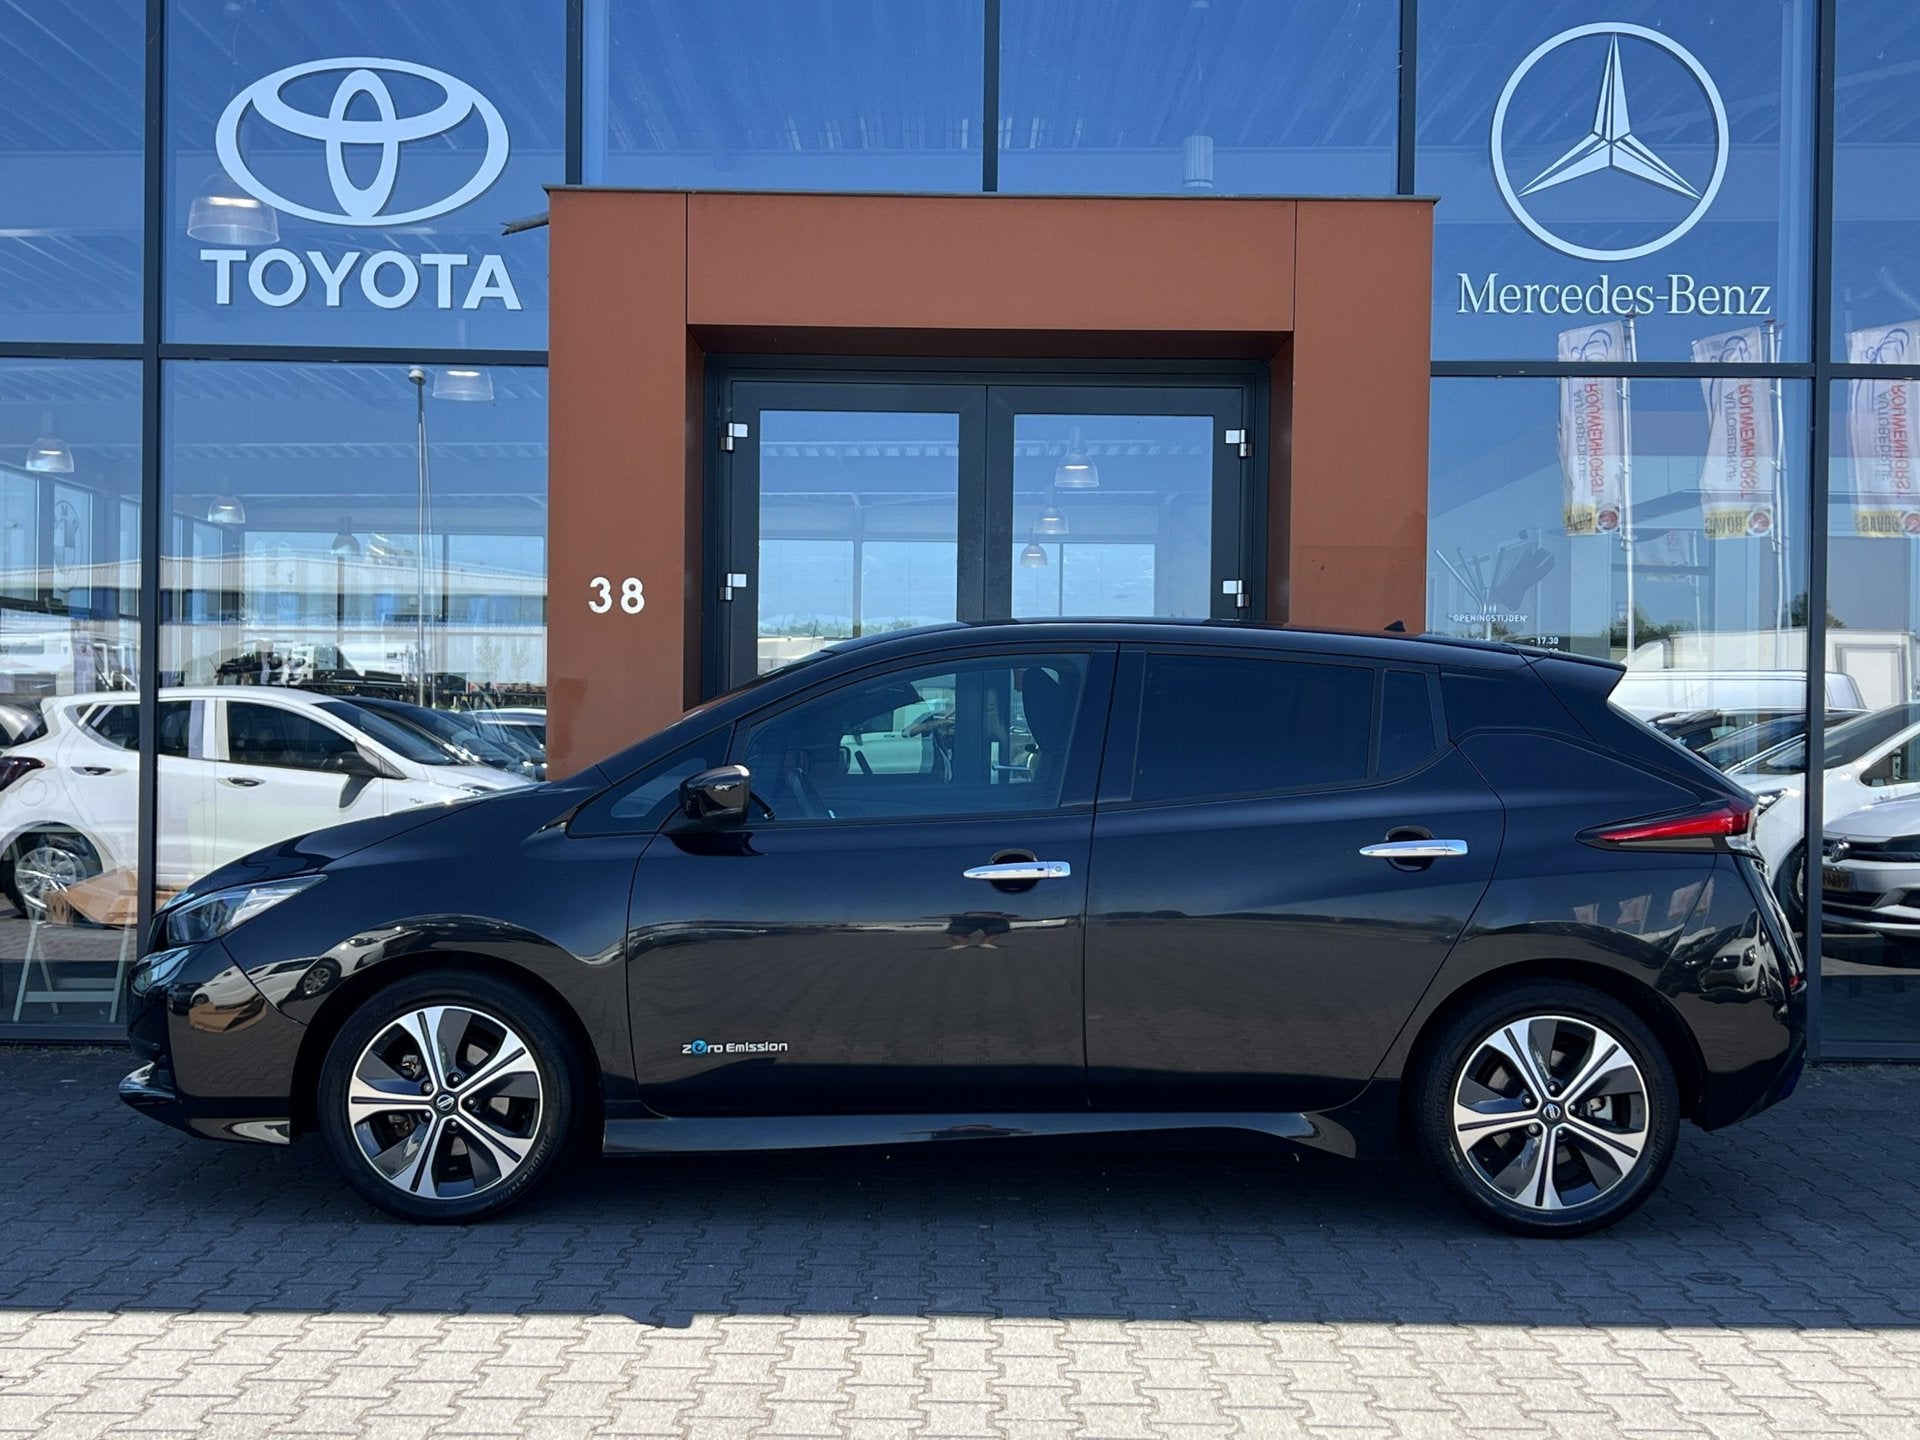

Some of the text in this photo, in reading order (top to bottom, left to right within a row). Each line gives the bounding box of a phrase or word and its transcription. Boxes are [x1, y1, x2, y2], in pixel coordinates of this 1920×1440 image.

[200, 248, 522, 311] TOYOTA
[1457, 273, 1771, 316] Mercedes-Benz
[588, 576, 645, 615] 38
[1537, 636, 1559, 645] 17.30
[726, 1041, 788, 1053] Emission
